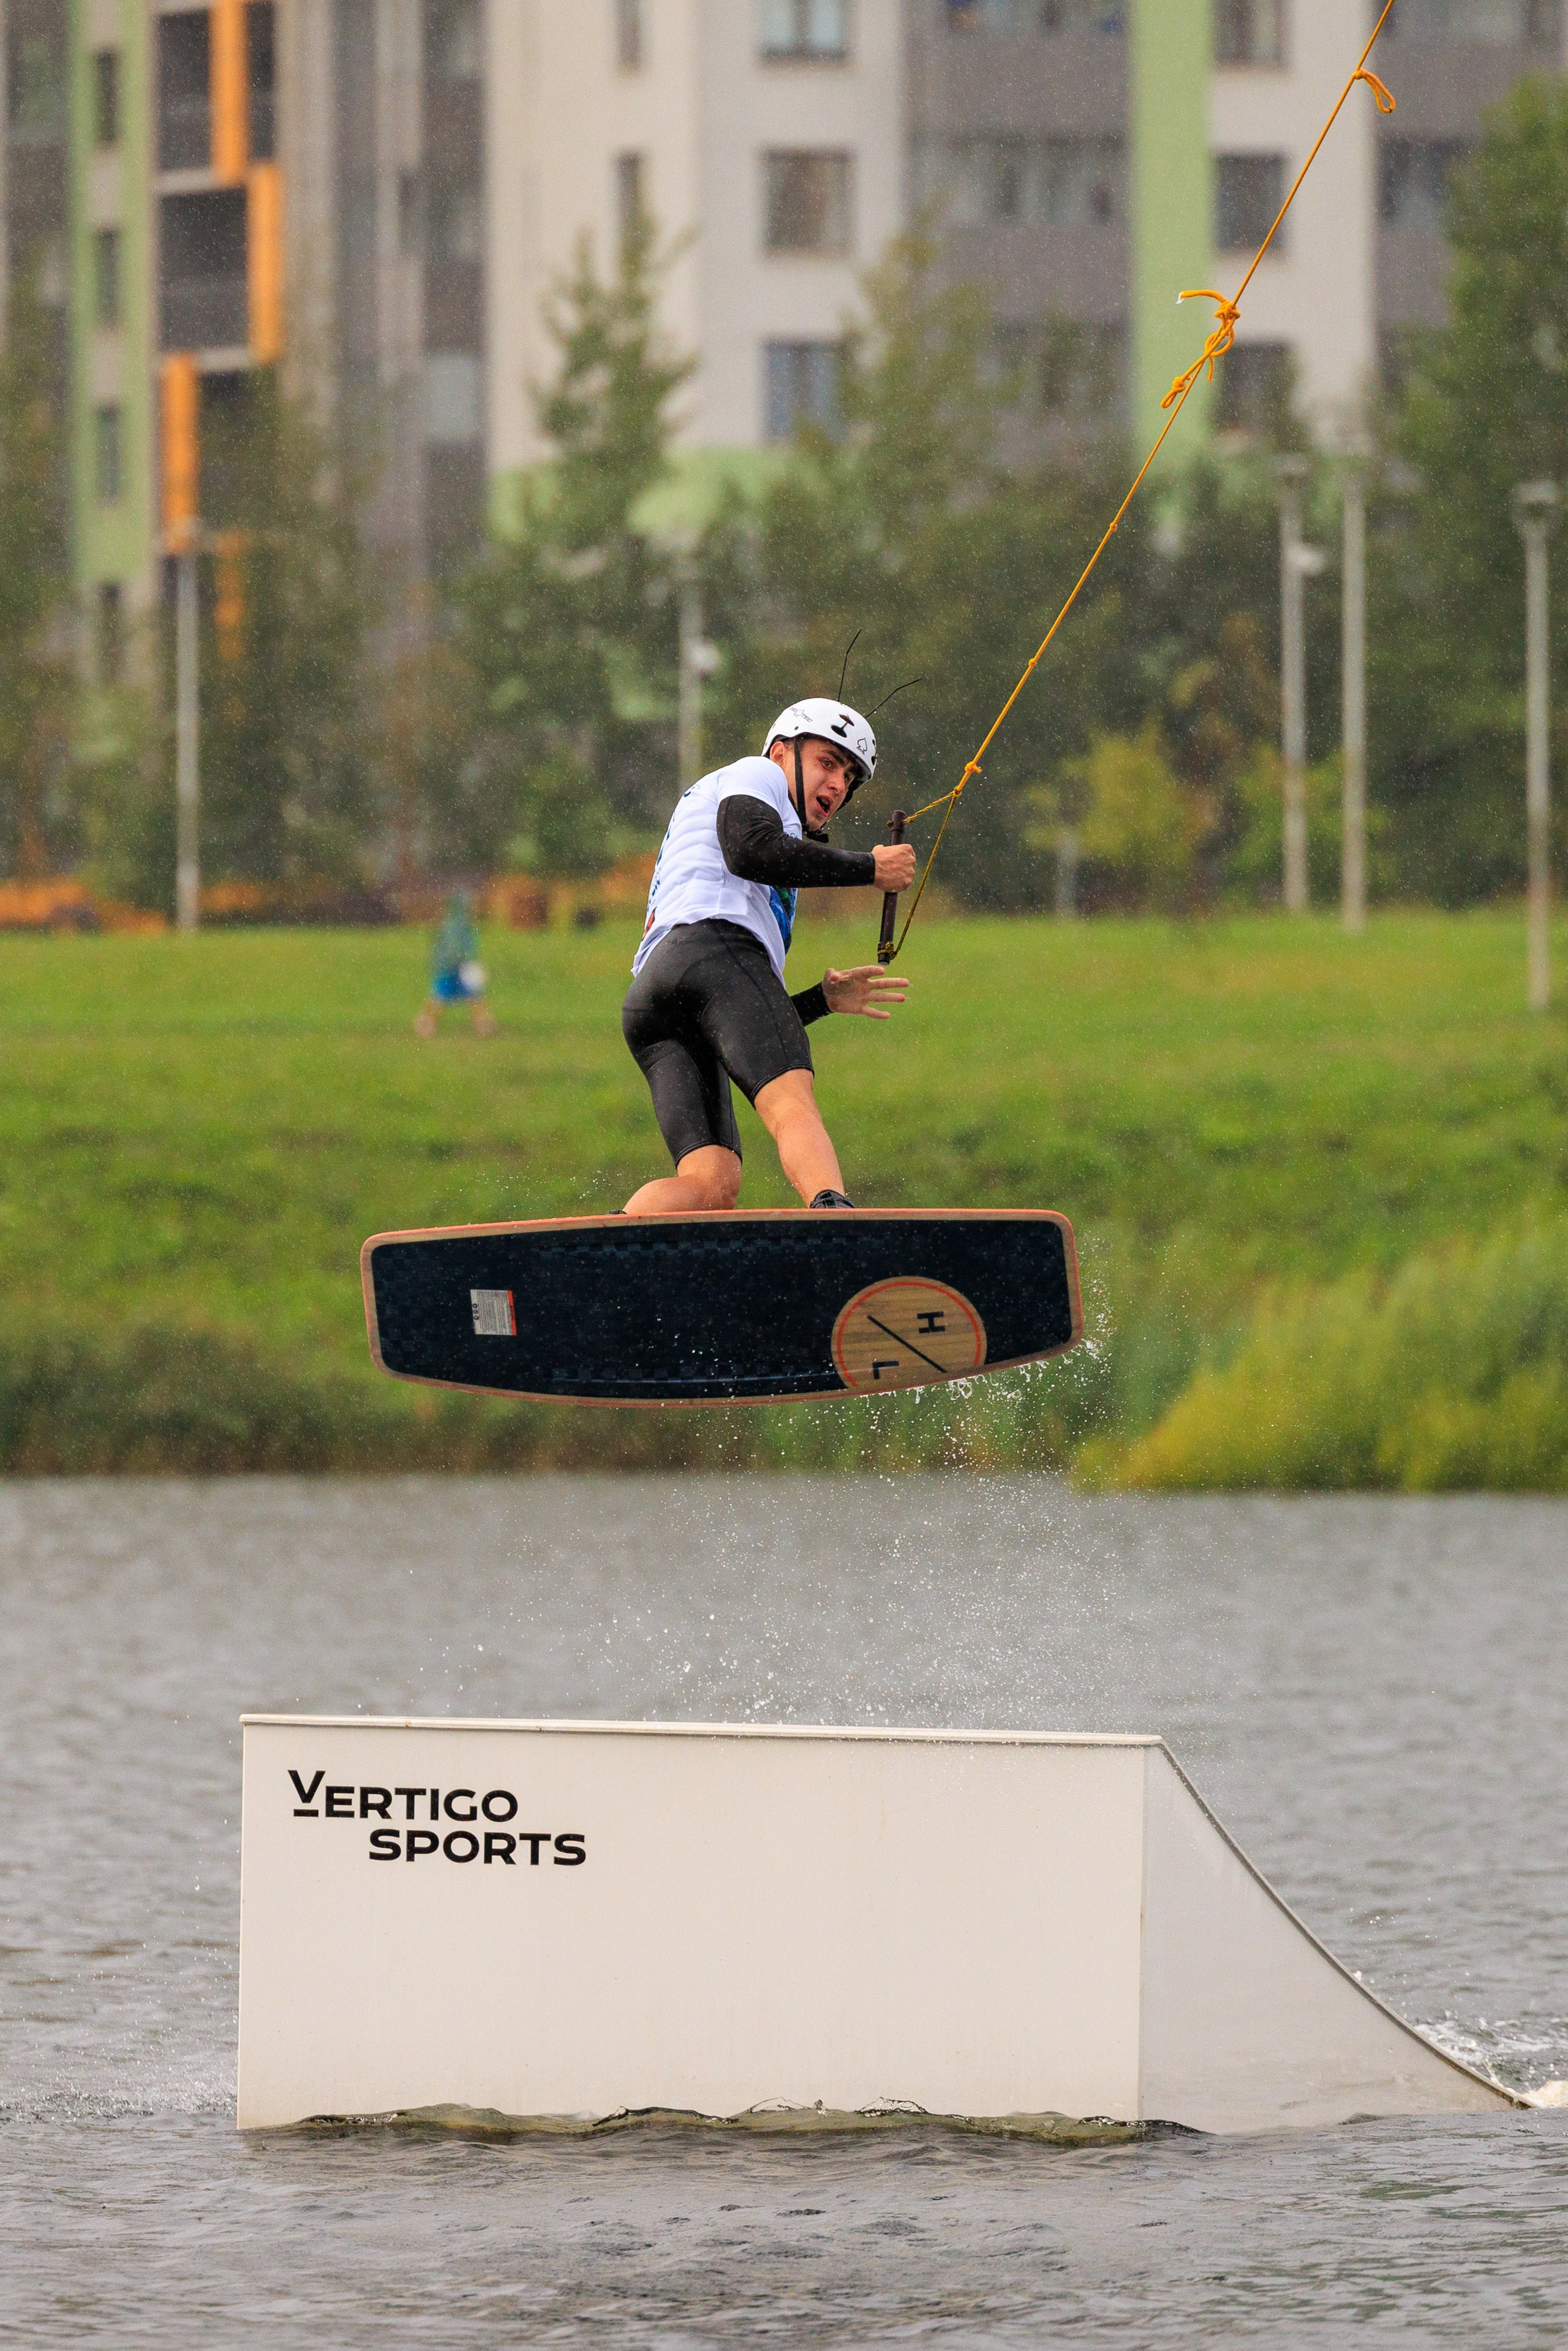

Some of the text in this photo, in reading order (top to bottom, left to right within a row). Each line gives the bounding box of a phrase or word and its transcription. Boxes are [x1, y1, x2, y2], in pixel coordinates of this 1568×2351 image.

[801, 713, 813, 723] TEC
[287, 1769, 518, 1823] VERTIGO
[369, 1828, 586, 1866] SPORTS
